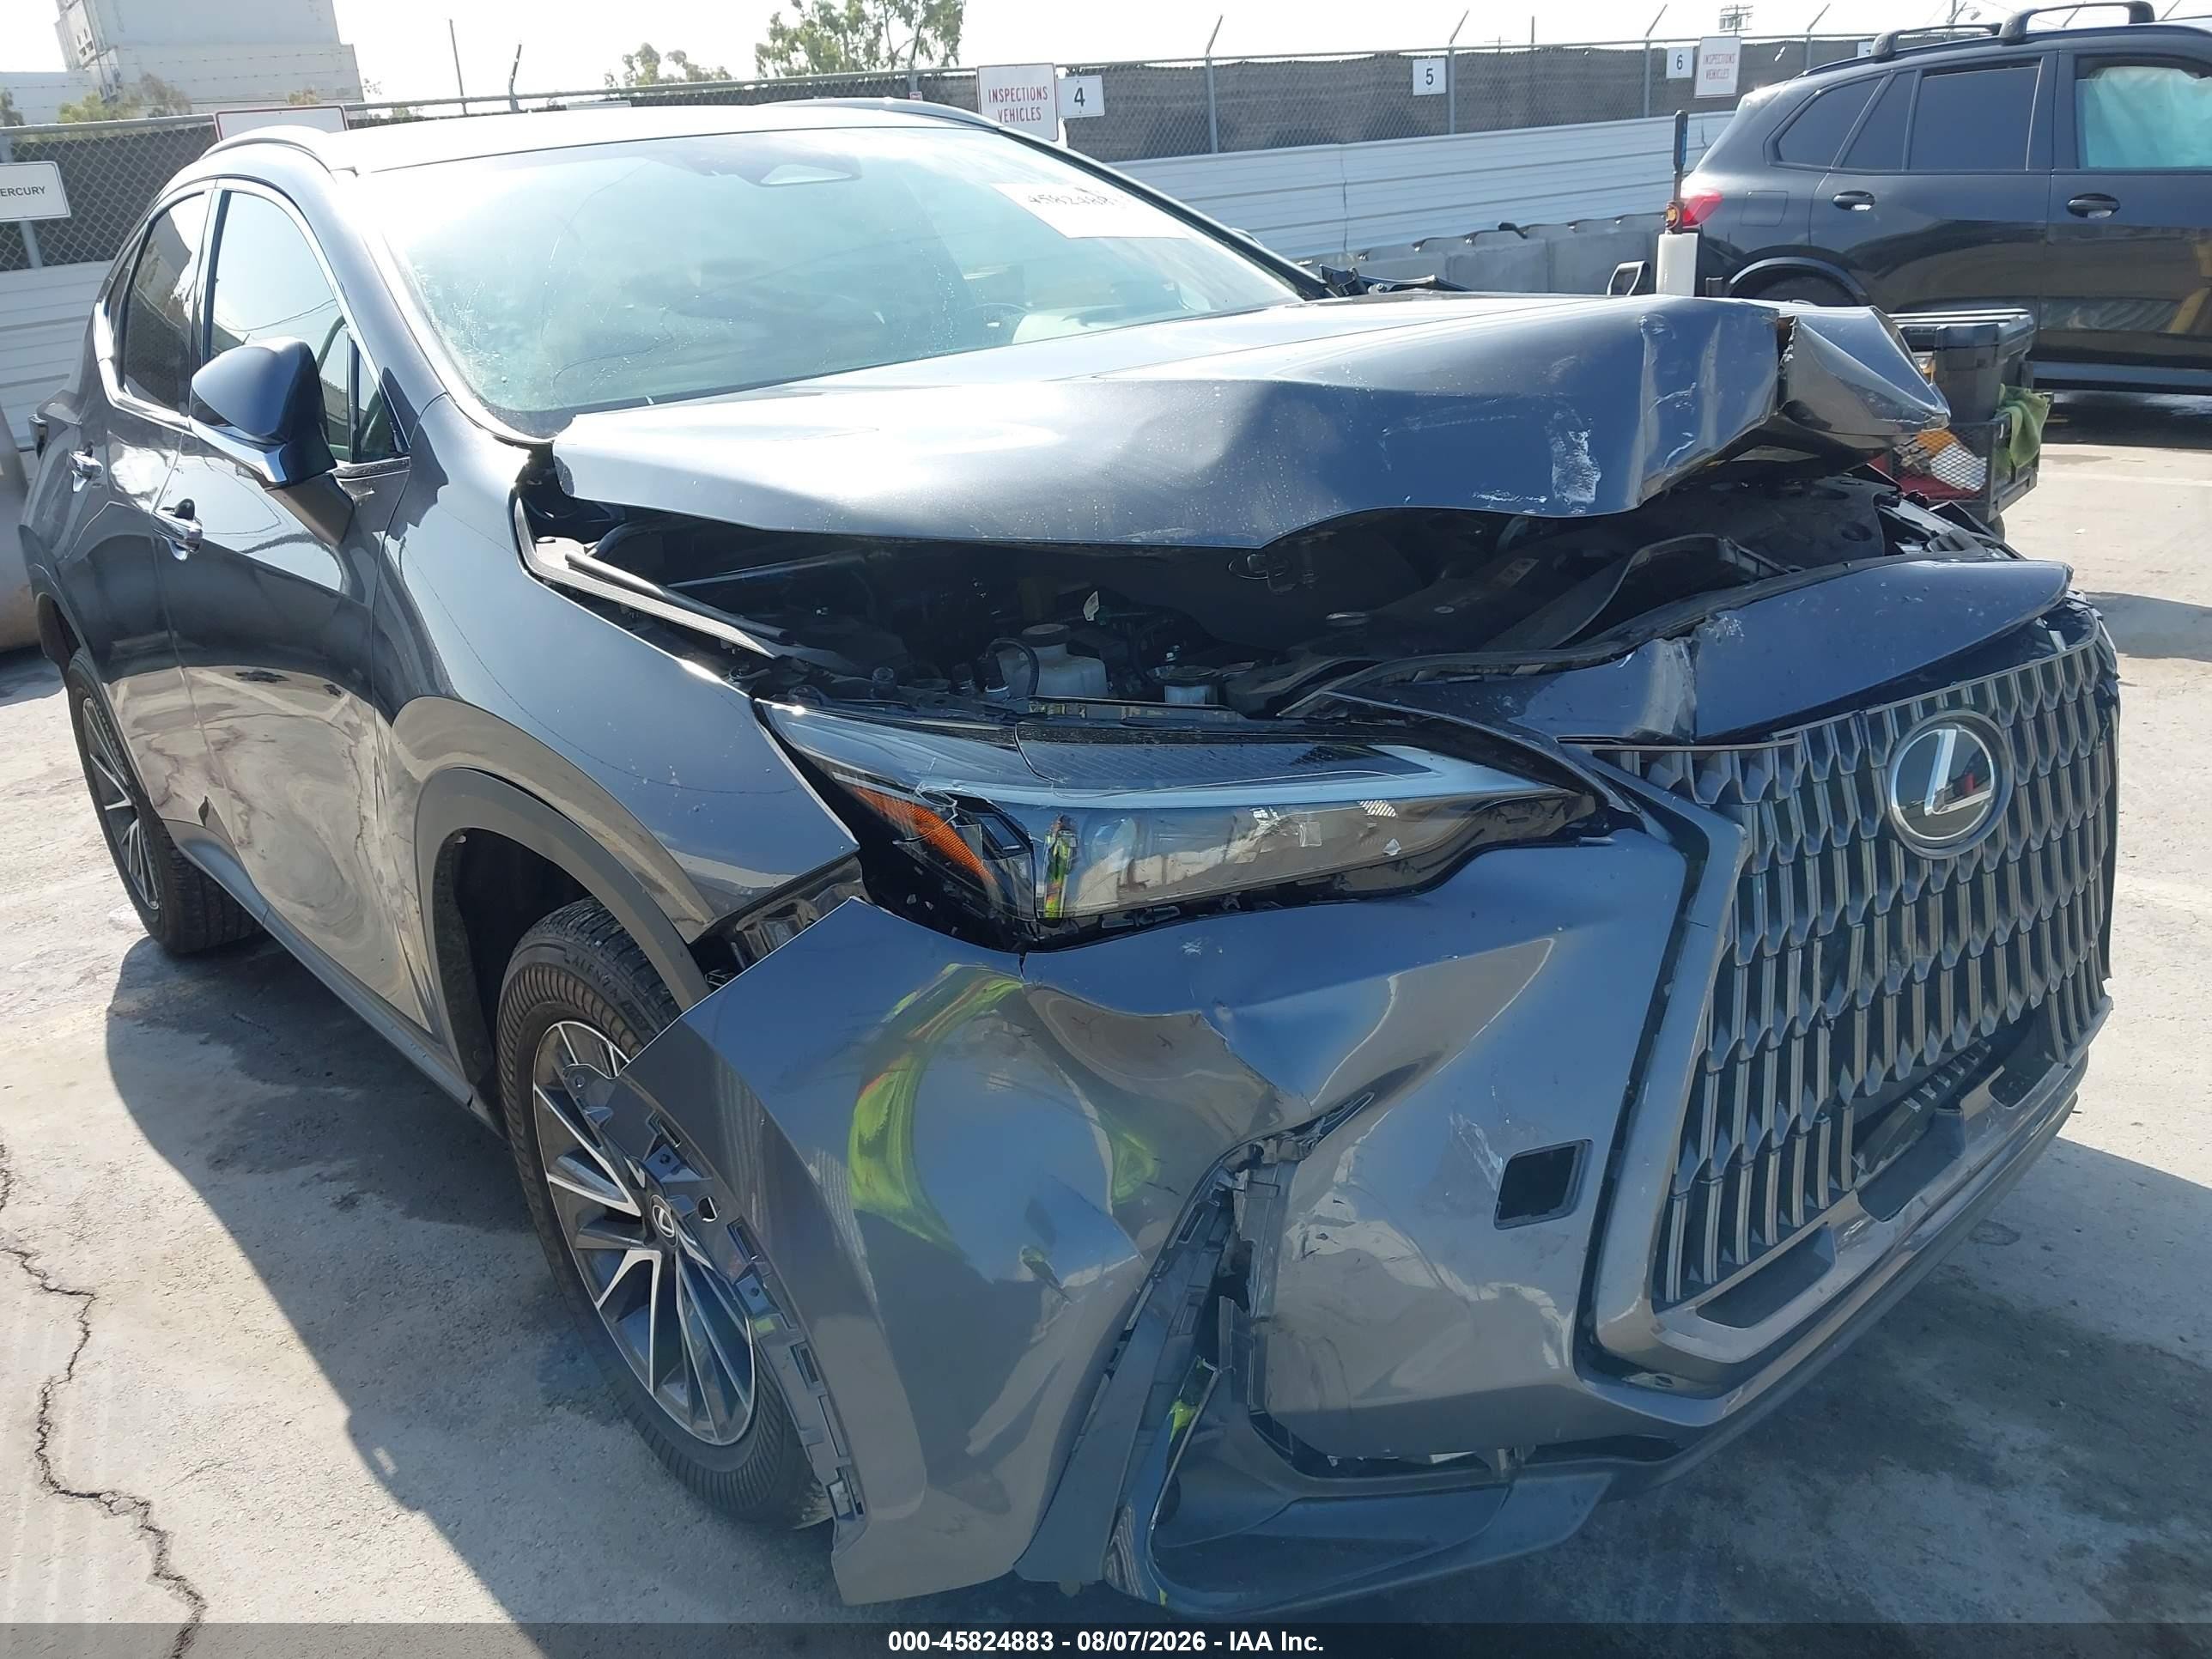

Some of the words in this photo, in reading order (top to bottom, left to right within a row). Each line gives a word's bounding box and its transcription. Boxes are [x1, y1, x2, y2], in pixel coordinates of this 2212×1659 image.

[1676, 54, 1683, 70] 6
[1425, 68, 1434, 86] 5
[988, 86, 1048, 103] INSPECTIONS
[1073, 87, 1086, 107] 4
[997, 106, 1042, 123] VEHICLES
[0, 185, 46, 198] ERCURY
